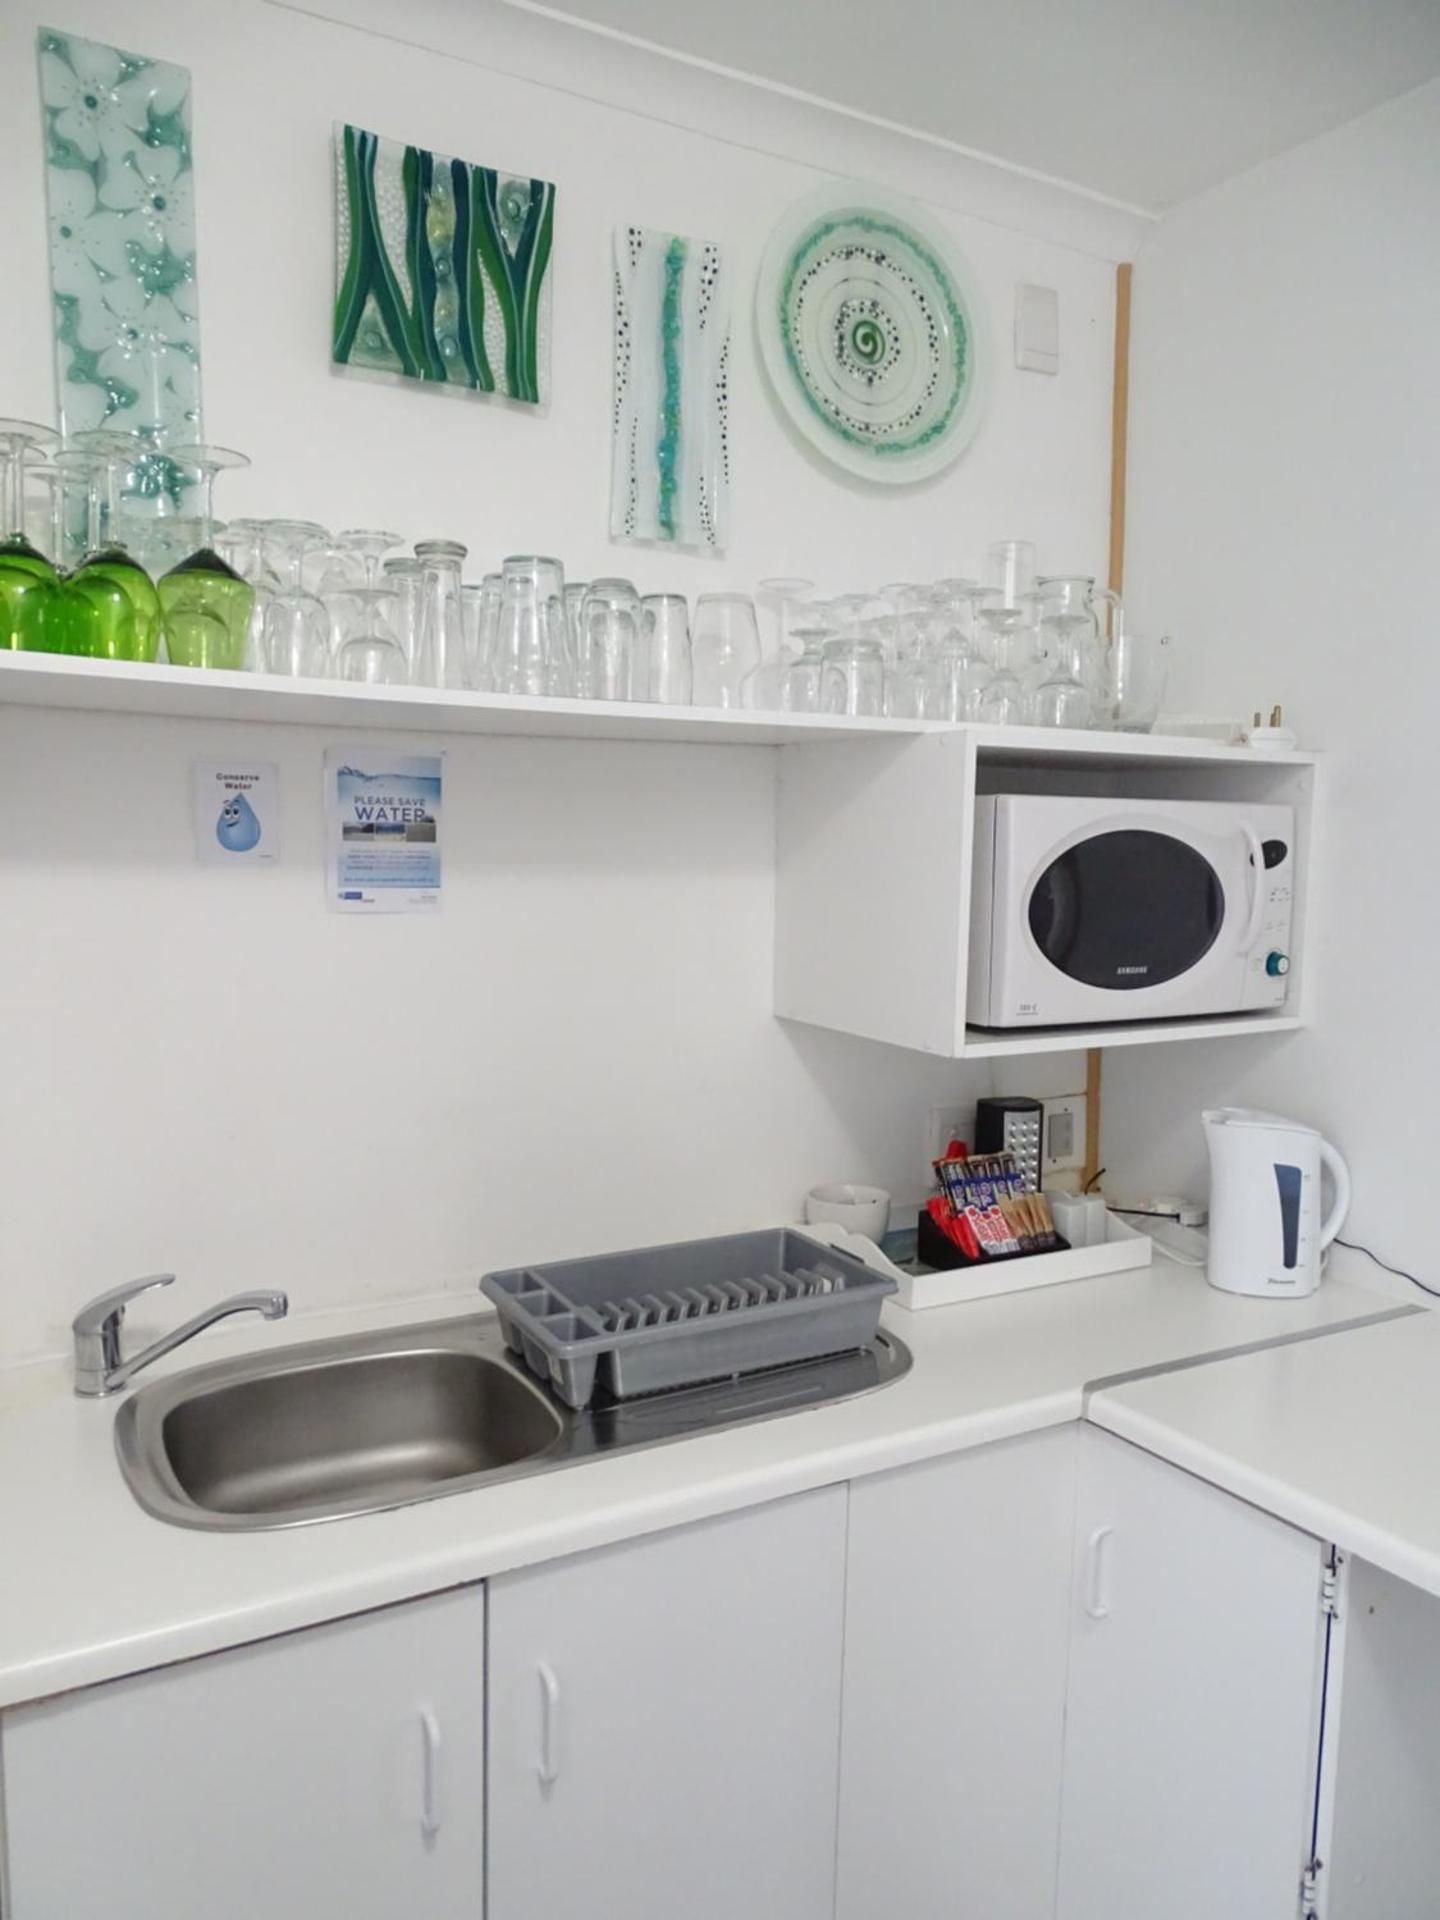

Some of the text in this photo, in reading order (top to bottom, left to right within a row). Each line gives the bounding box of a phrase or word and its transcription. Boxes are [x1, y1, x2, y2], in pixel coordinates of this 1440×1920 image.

[216, 772, 260, 781] Conserve
[224, 782, 253, 790] Water
[354, 796, 426, 807] PLEASE SAVE
[354, 807, 426, 823] WATER
[1116, 966, 1148, 974] SAMSUNG
